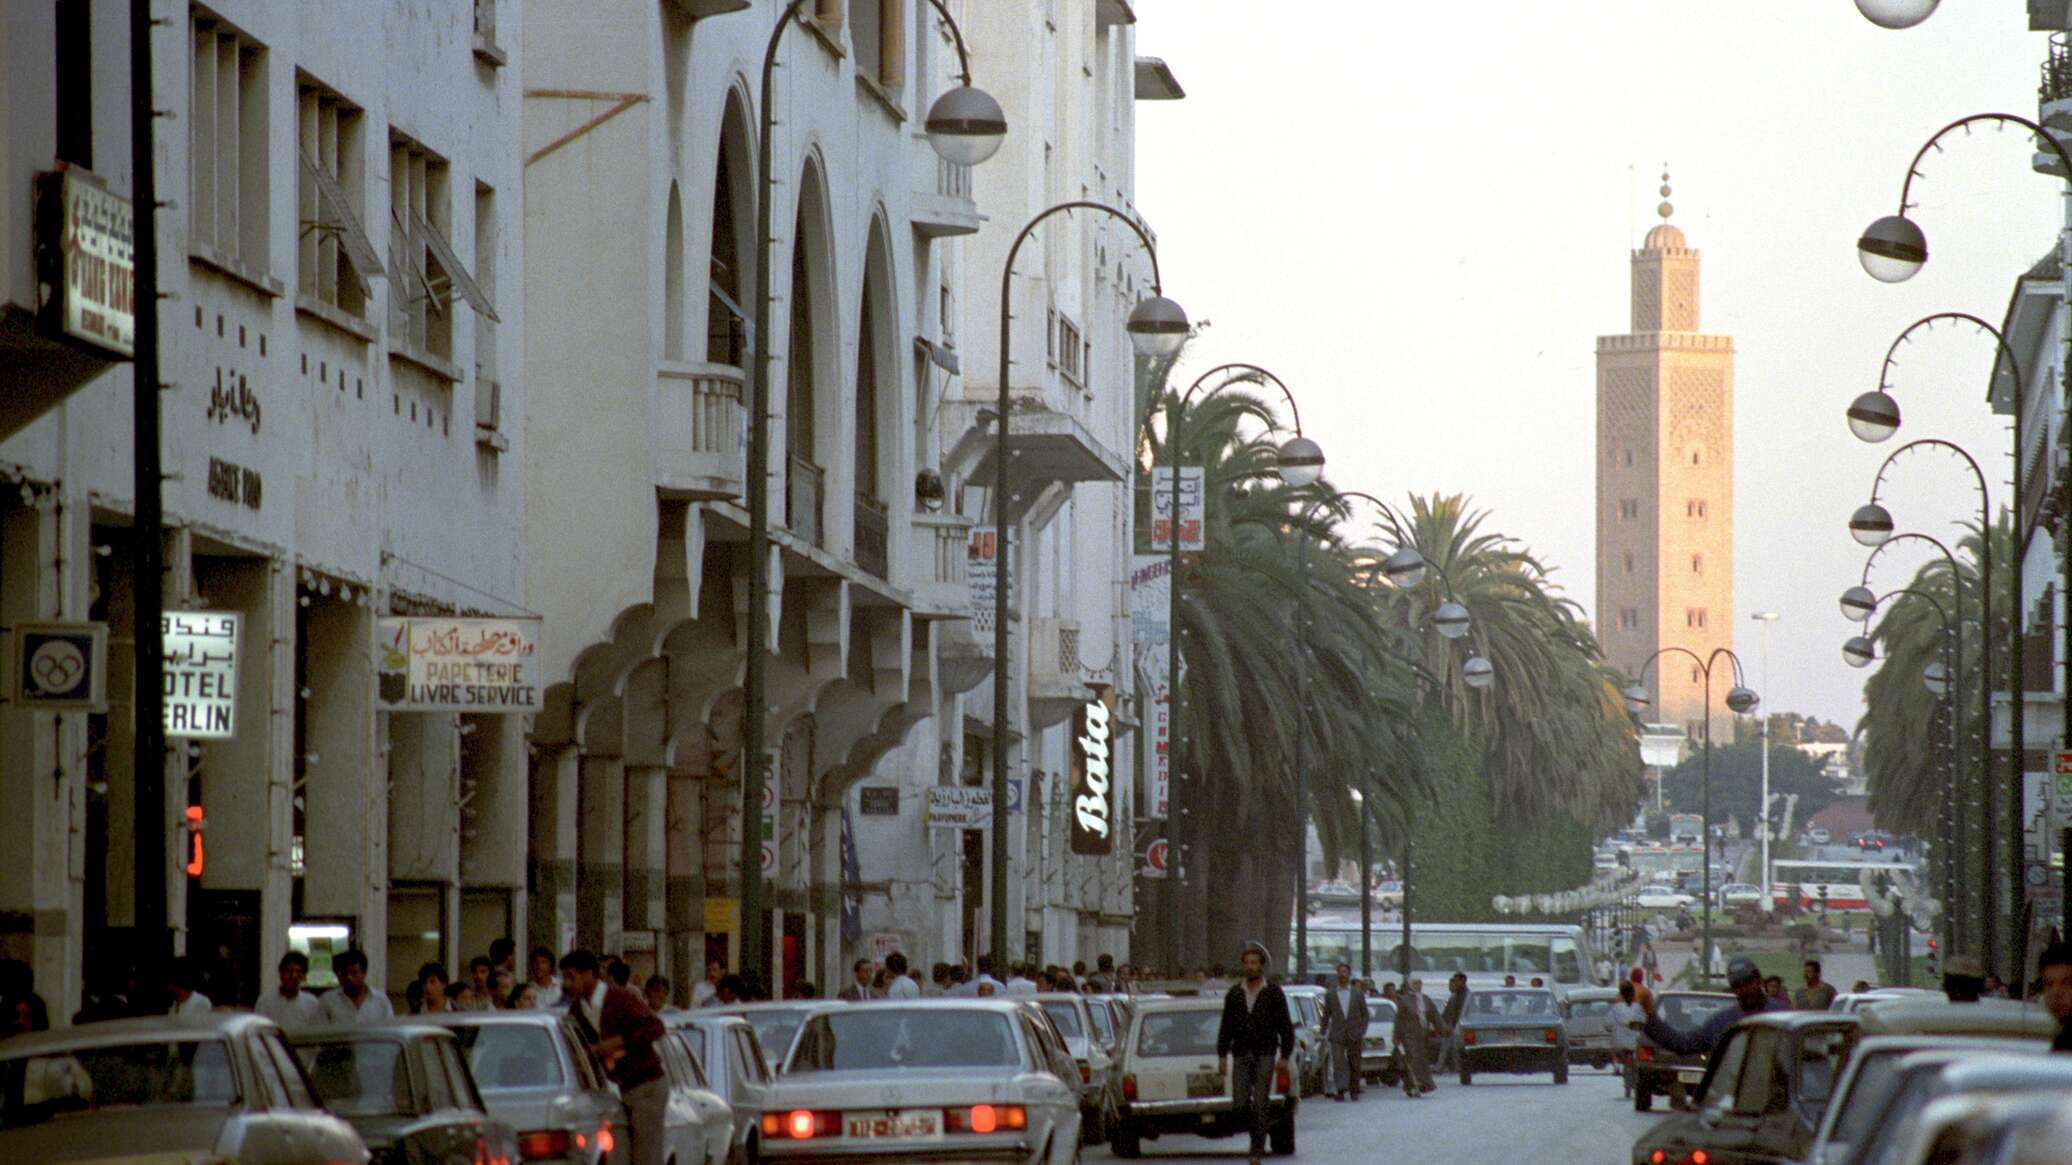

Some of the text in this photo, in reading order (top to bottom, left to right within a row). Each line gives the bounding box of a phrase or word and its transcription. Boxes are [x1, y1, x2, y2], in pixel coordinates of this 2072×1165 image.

[161, 672, 231, 698] OTEL
[426, 663, 522, 683] PAPETERIE
[411, 684, 535, 705] LIVRE SERVICE
[161, 704, 231, 731] ERLIN
[1076, 699, 1110, 839] Bata
